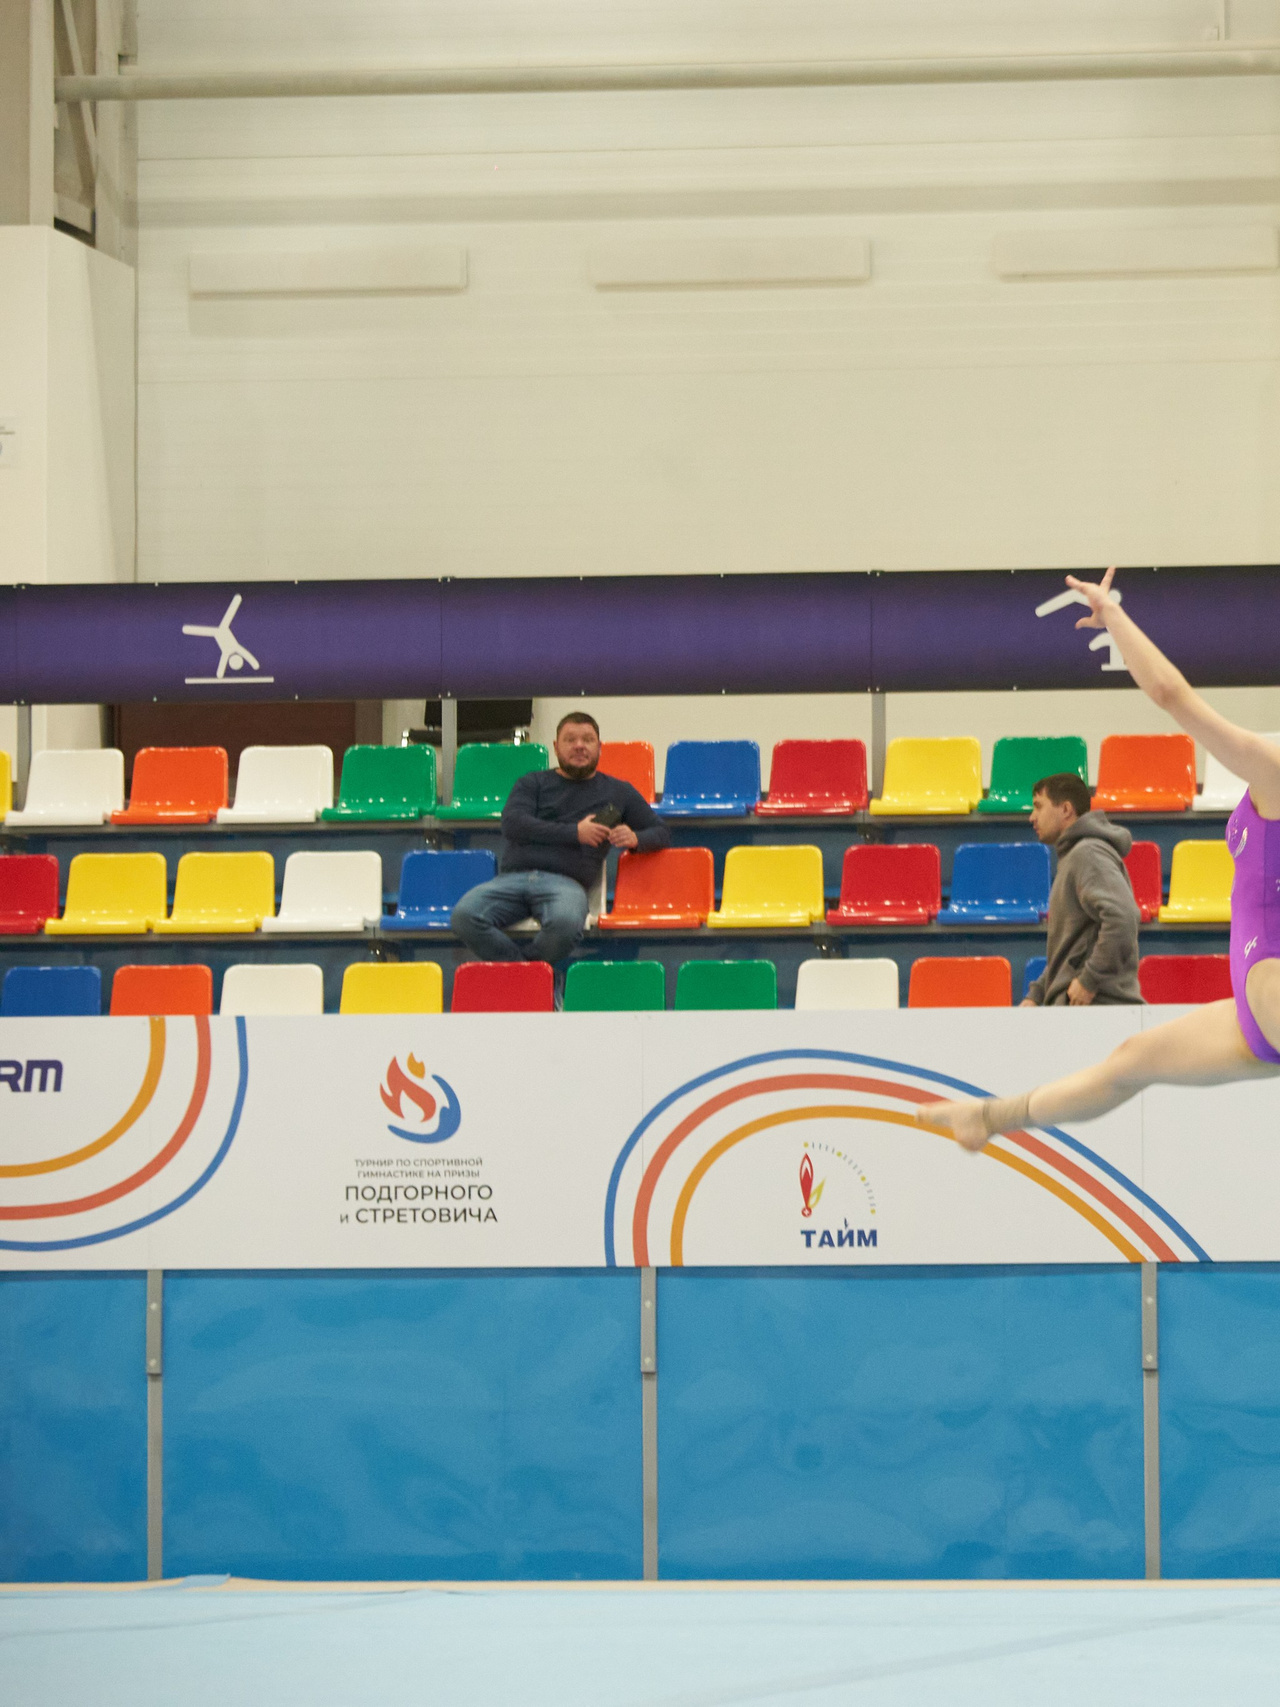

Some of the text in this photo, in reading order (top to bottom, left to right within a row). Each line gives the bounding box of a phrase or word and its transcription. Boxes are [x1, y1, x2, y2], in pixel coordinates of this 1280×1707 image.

[355, 1157, 483, 1167] ТУРНИР ПО СПОРТИВНОЙ
[358, 1170, 479, 1178] ГИМНАСТИКЕ НА ПРИЗЫ
[345, 1185, 493, 1203] ПОДГОРНОГО
[356, 1207, 498, 1223] СТРЕТОВИЧА
[800, 1217, 878, 1248] ТАЙМ
